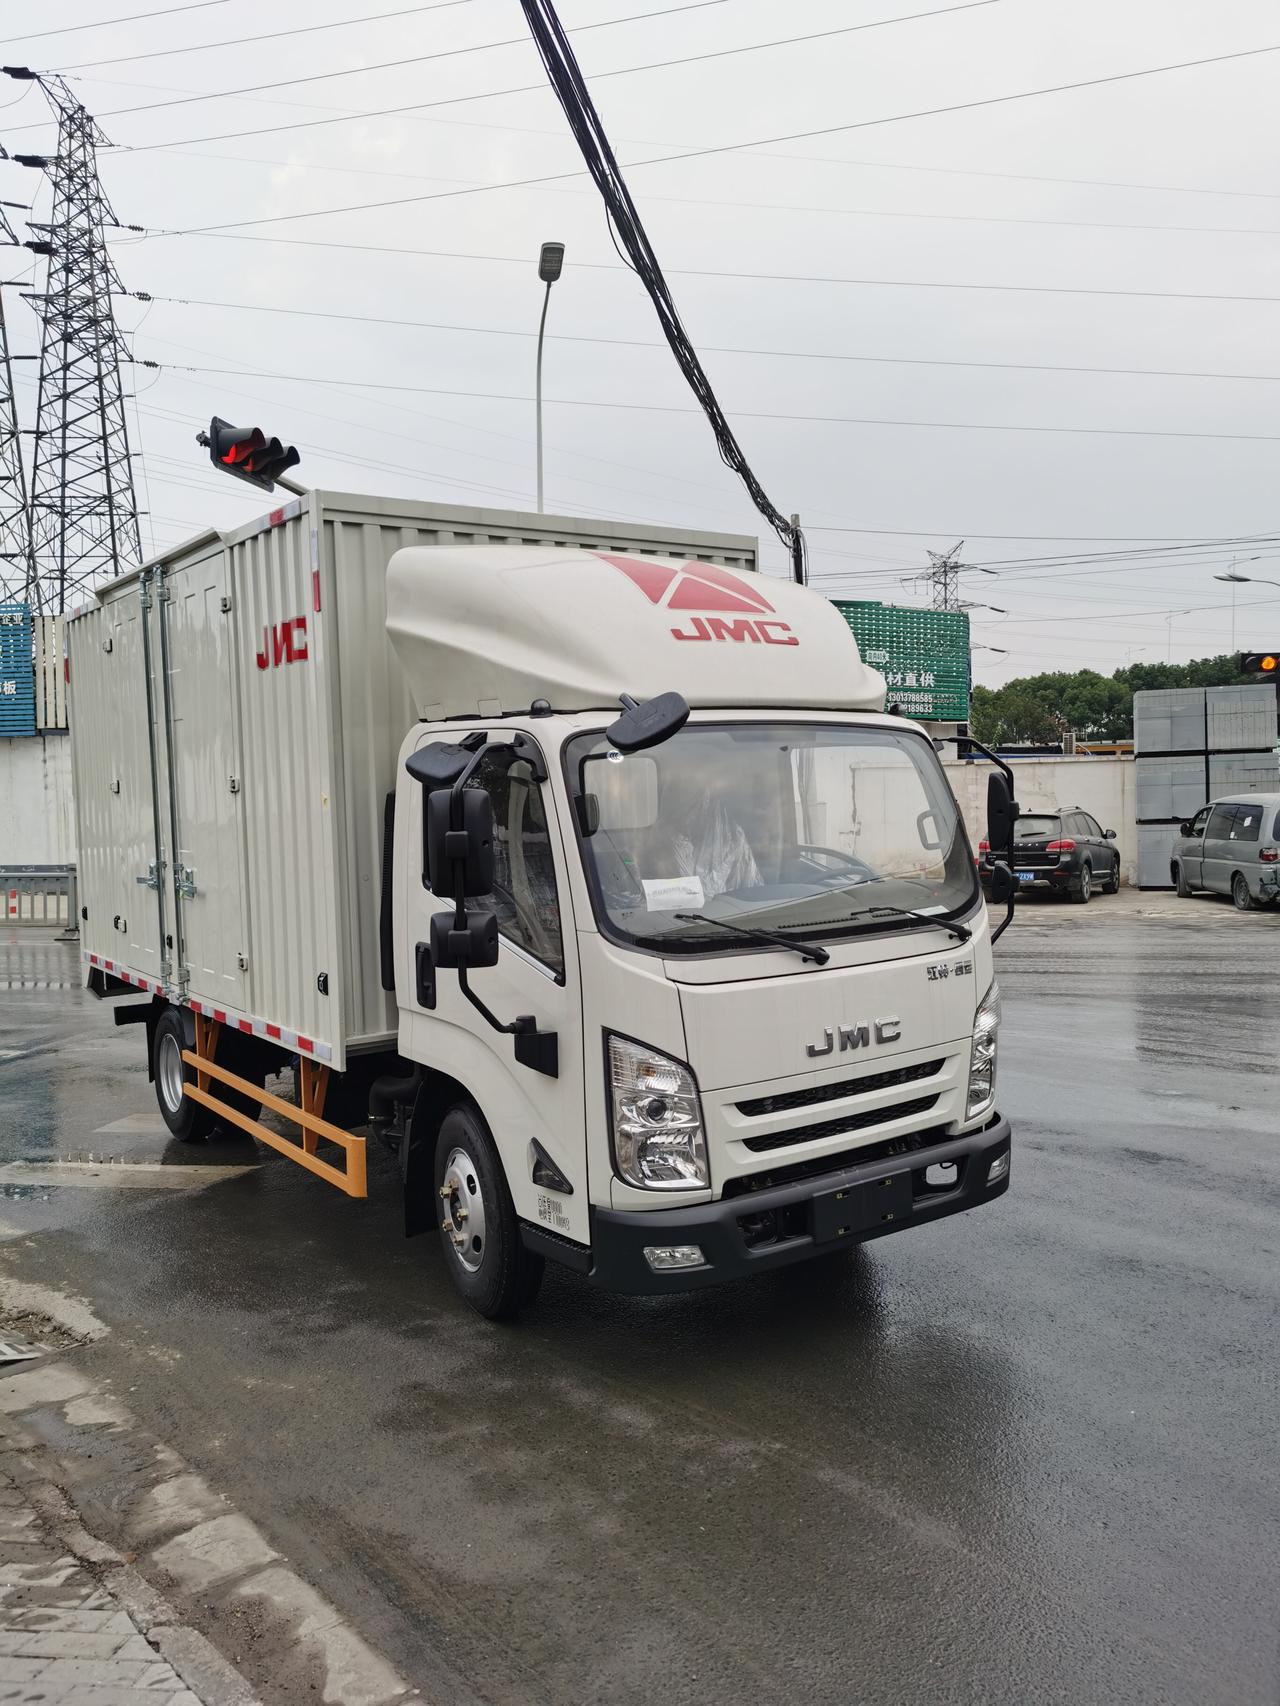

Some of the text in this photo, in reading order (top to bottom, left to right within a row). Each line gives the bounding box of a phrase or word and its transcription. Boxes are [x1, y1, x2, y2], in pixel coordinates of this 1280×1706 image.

[256, 616, 308, 670] JMC
[670, 617, 800, 646] JMC
[806, 1015, 901, 1057] JMC
